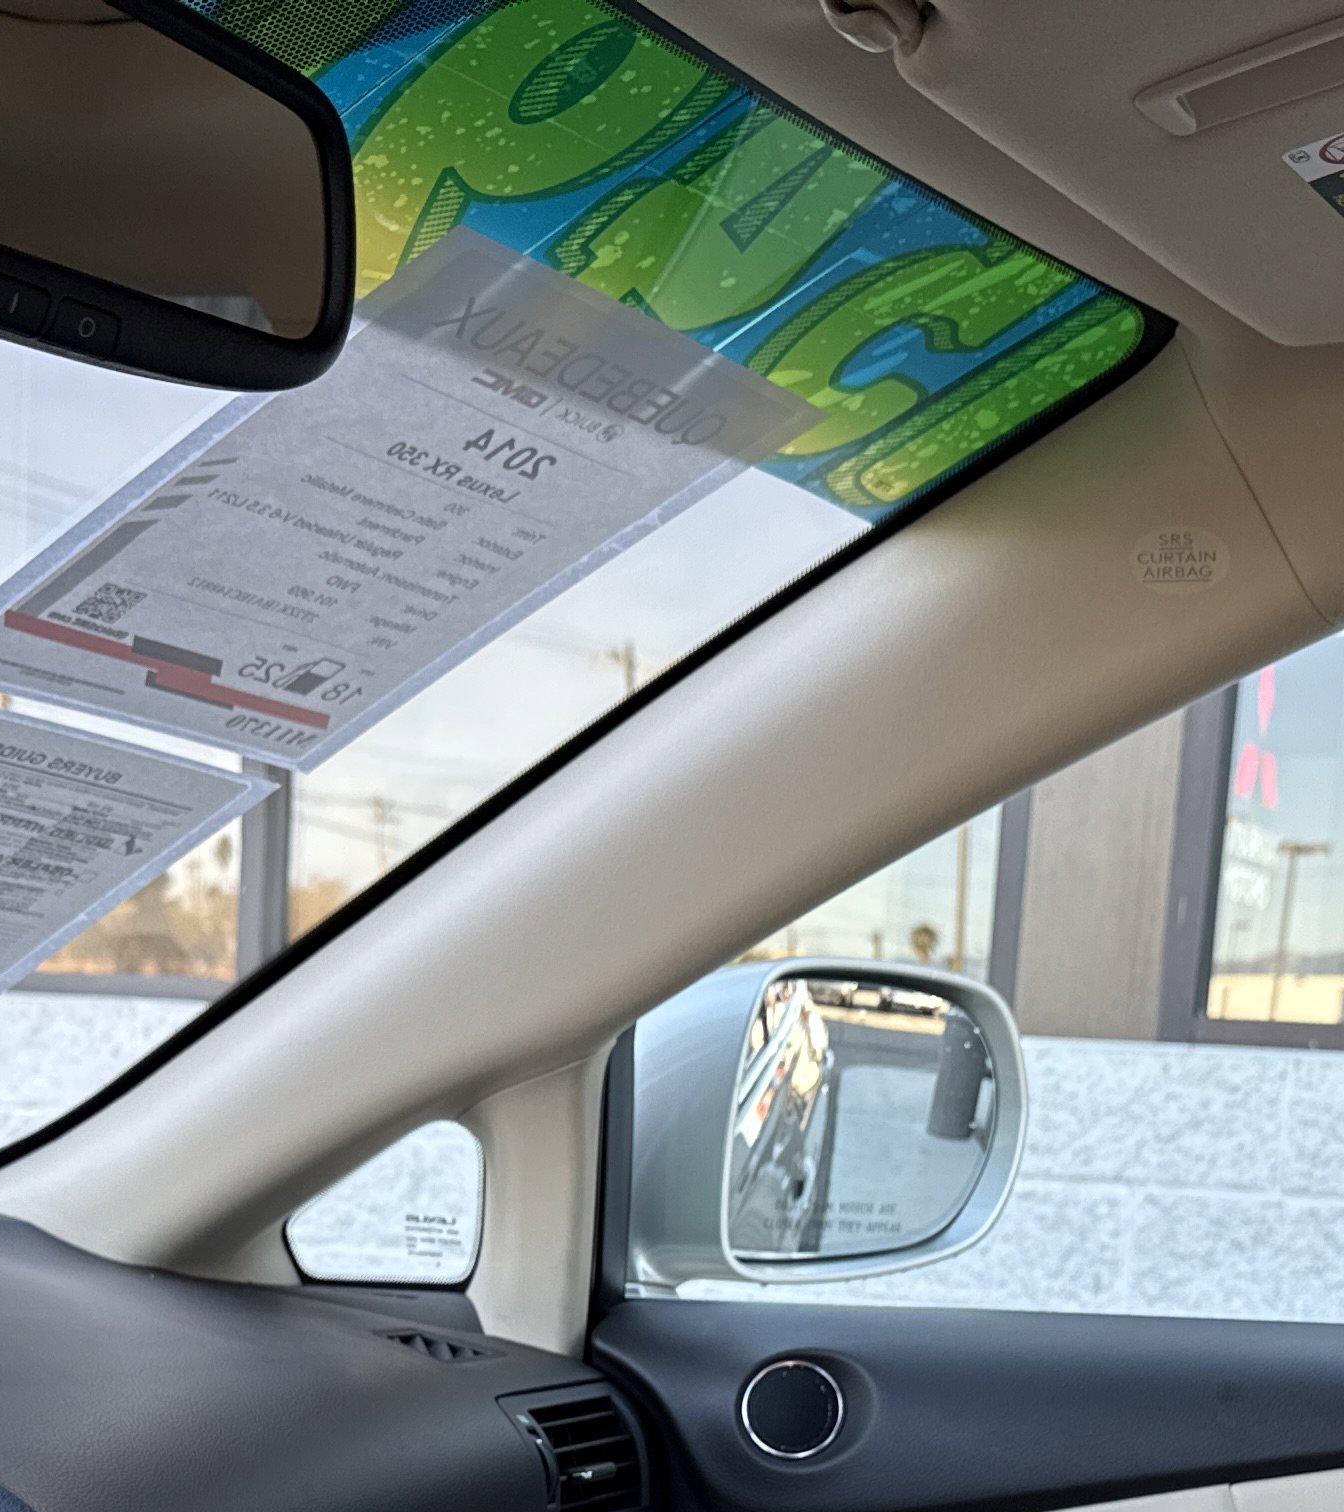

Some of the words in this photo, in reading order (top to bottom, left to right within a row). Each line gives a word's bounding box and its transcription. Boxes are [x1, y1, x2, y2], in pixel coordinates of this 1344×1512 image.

[1159, 531, 1193, 546] SRS
[1137, 551, 1216, 565] CURTAIN
[1143, 565, 1213, 578] AIRBAG
